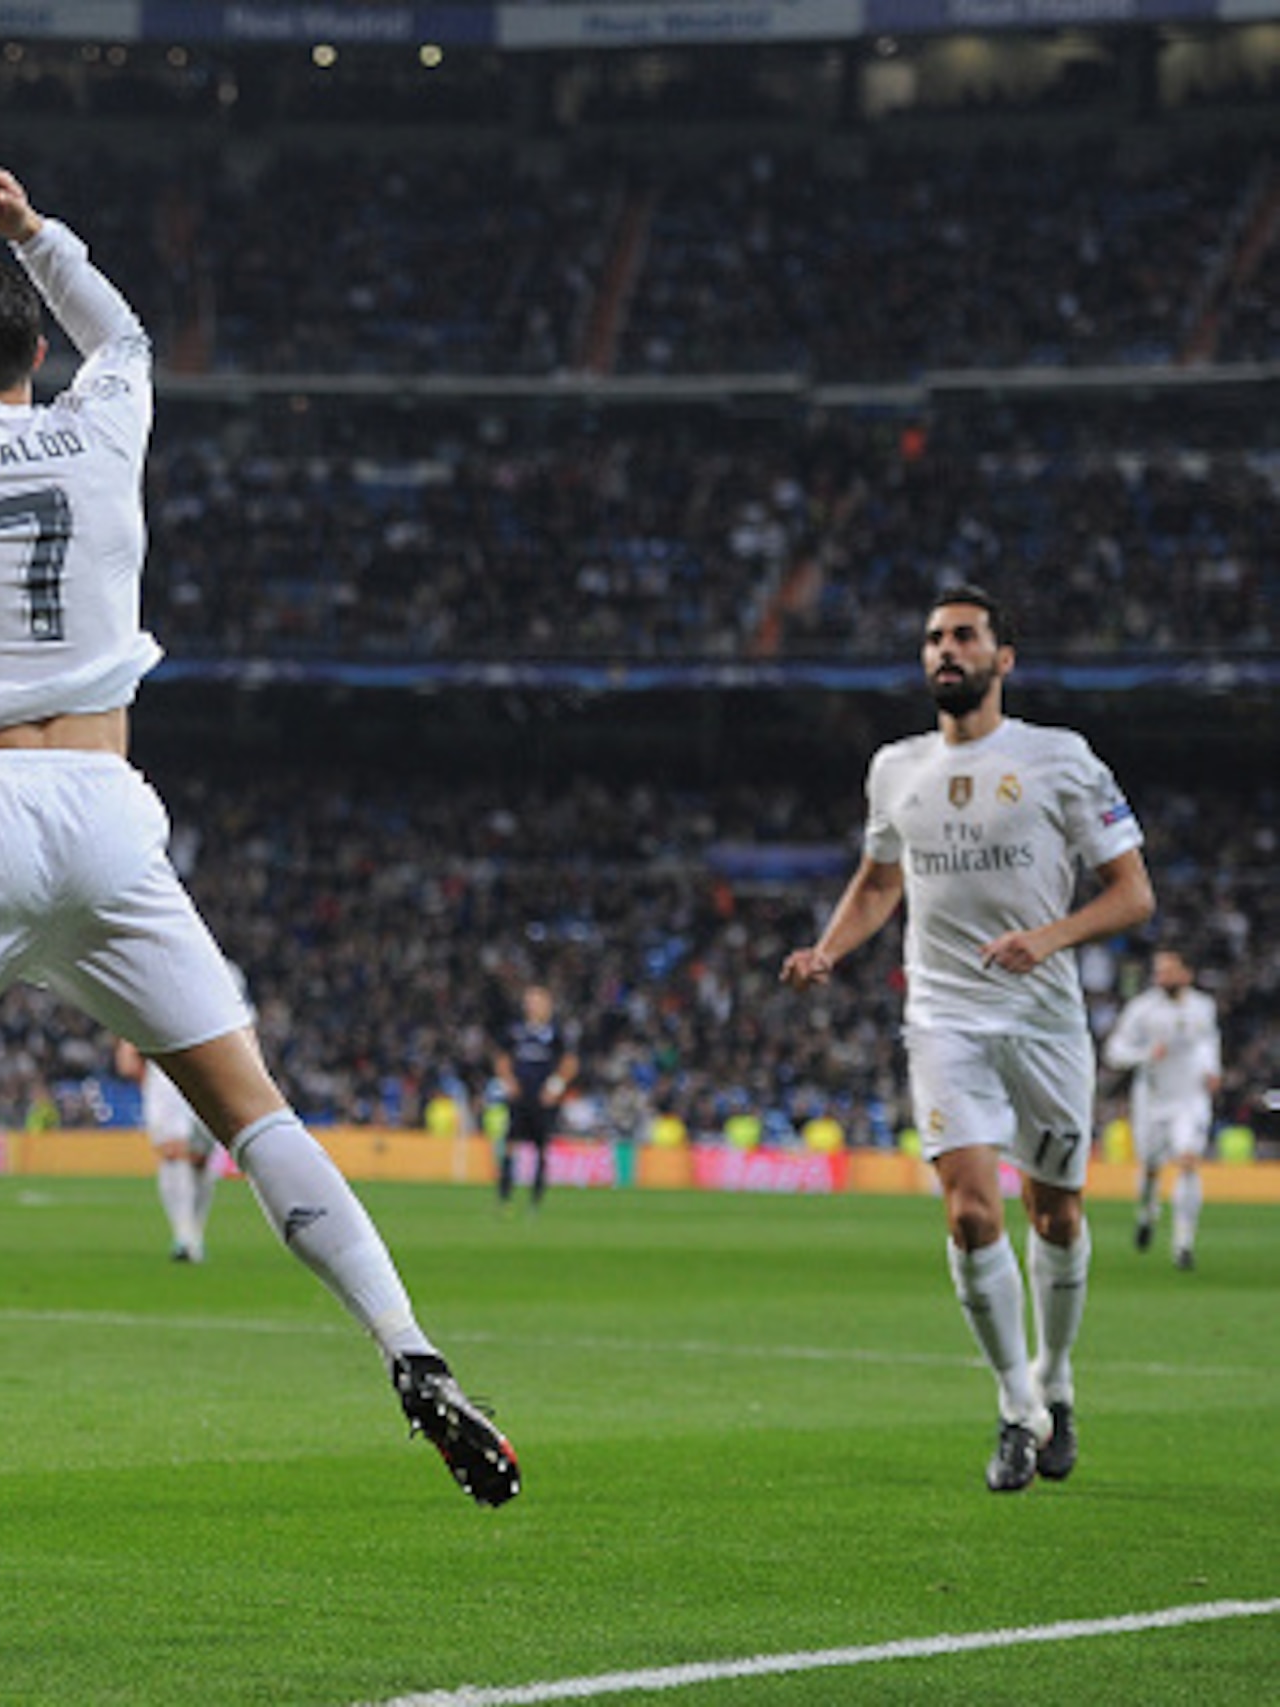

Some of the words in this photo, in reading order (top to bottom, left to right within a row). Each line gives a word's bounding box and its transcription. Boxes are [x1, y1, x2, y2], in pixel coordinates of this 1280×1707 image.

[943, 822, 983, 842] Fly
[910, 842, 1035, 876] Emirates
[1033, 1128, 1081, 1177] 17
